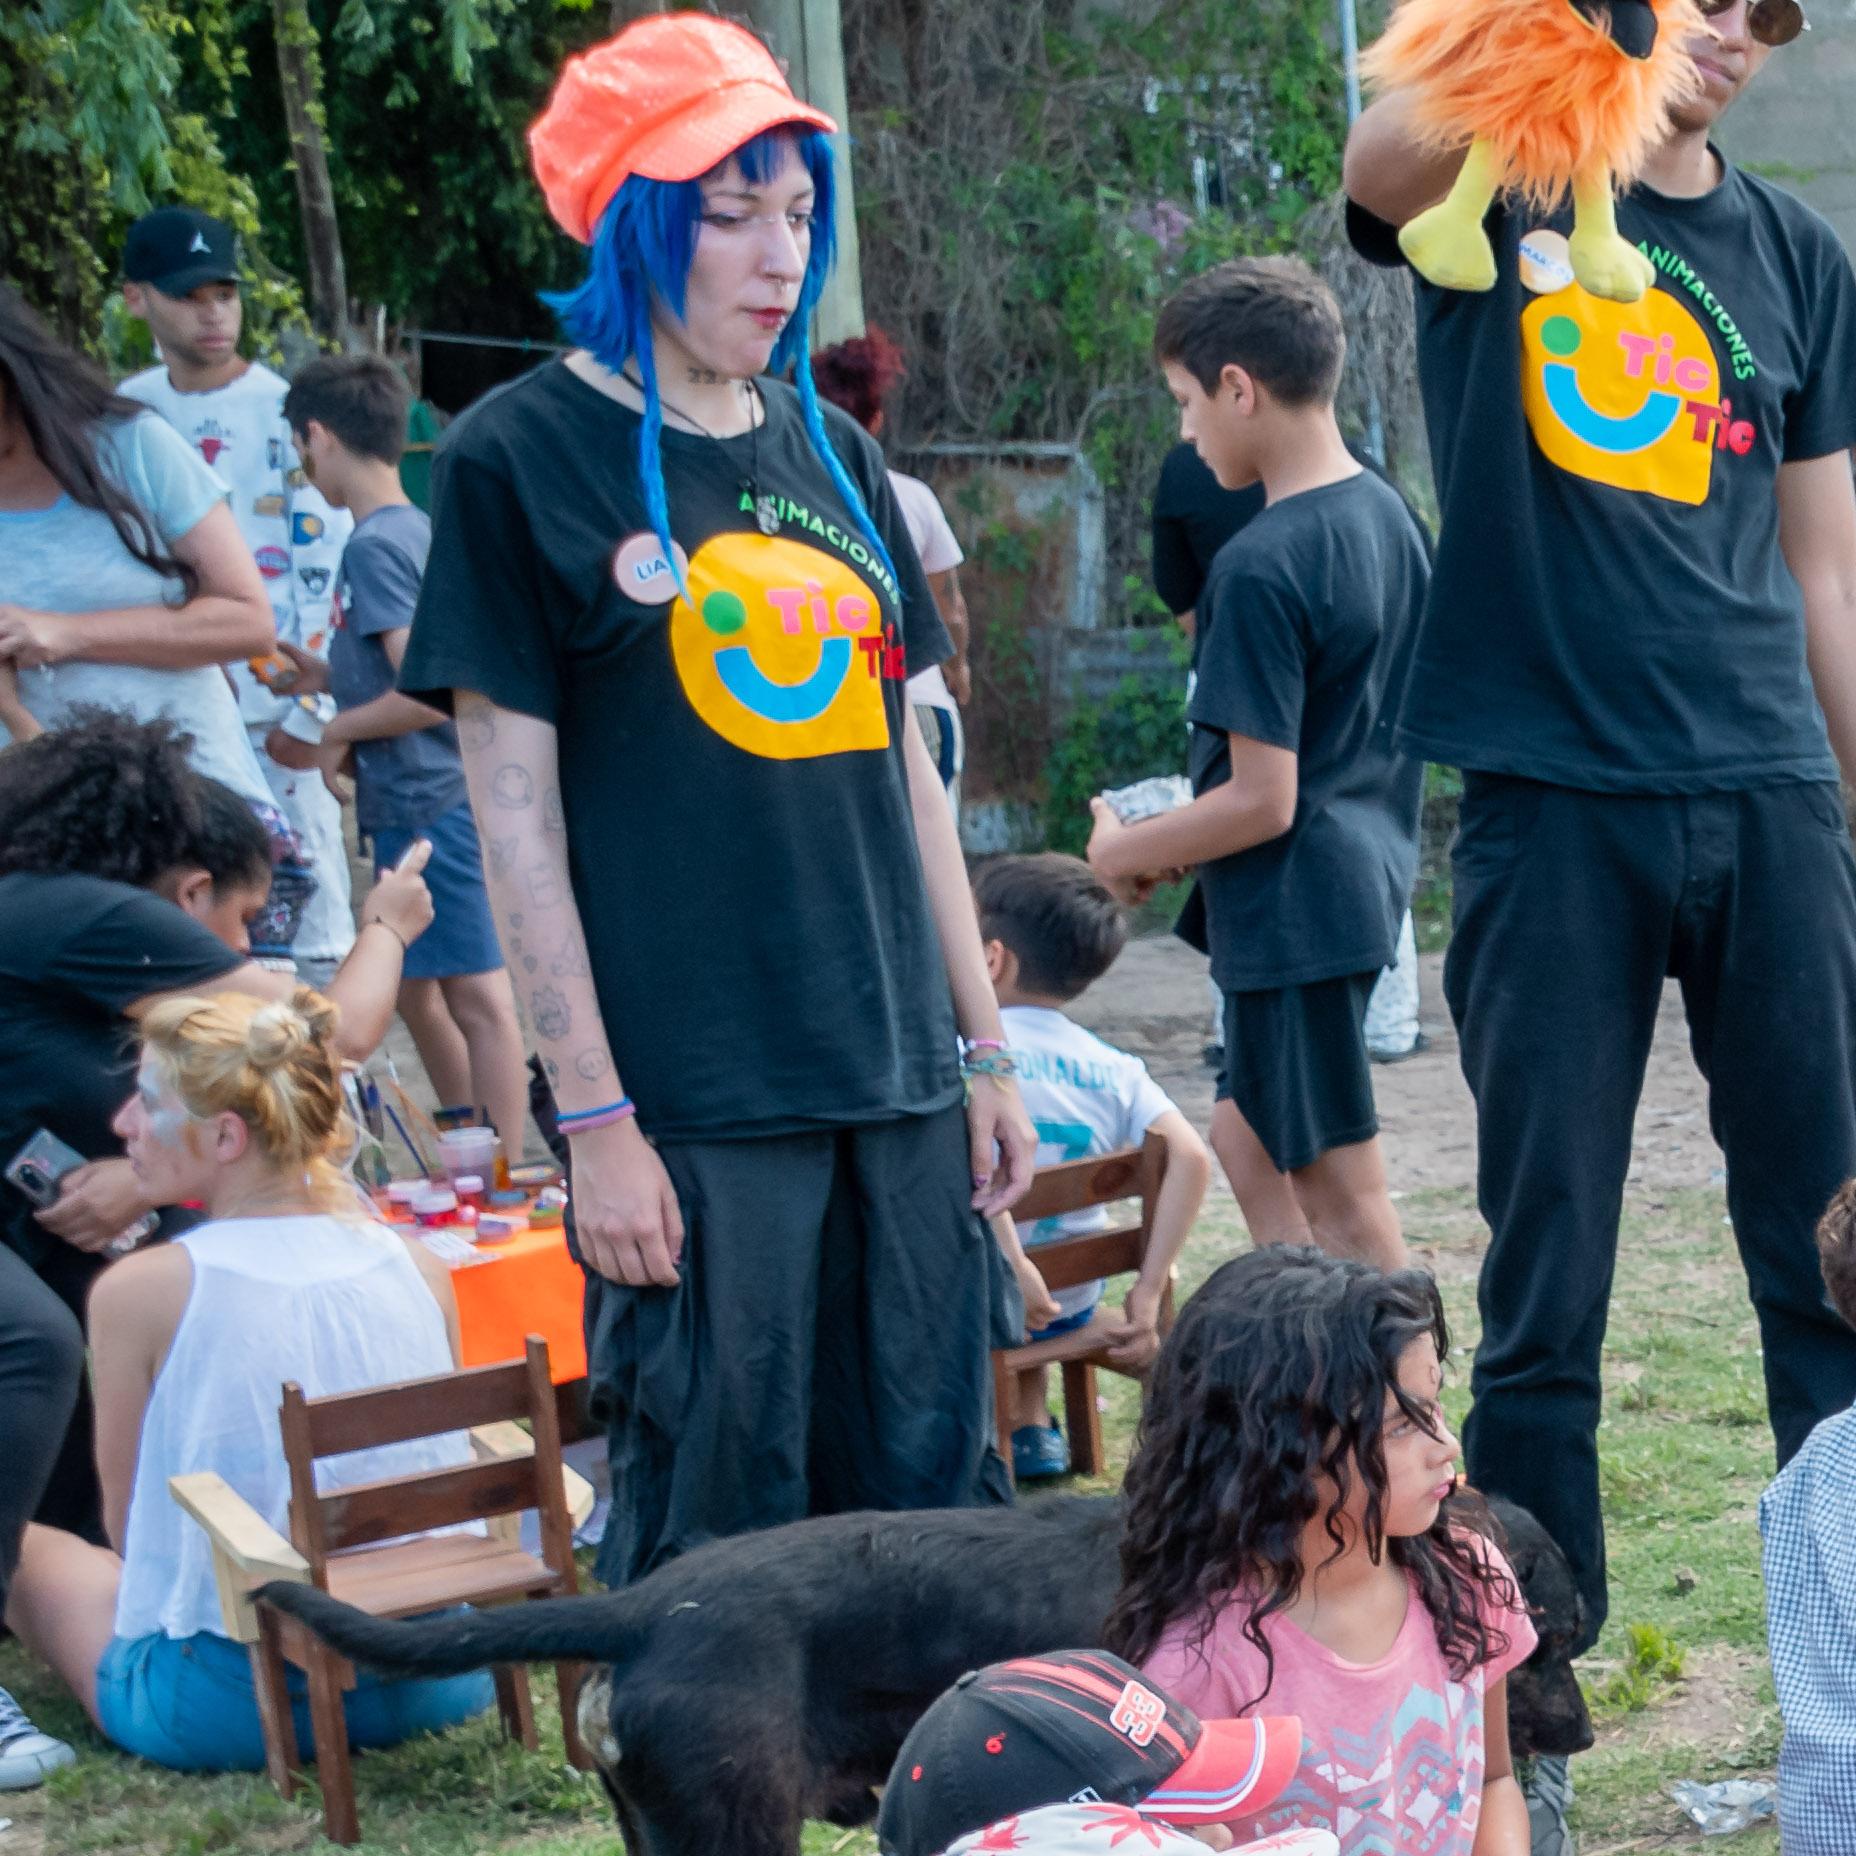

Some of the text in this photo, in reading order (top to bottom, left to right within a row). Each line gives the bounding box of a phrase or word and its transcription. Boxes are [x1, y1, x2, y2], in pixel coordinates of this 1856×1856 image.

[1637, 240, 1755, 380] ANIMACIONES
[1618, 330, 1711, 393] Tic
[1686, 399, 1756, 456] Tic
[739, 491, 898, 605] AIMACIONES
[766, 579, 870, 635] Tic
